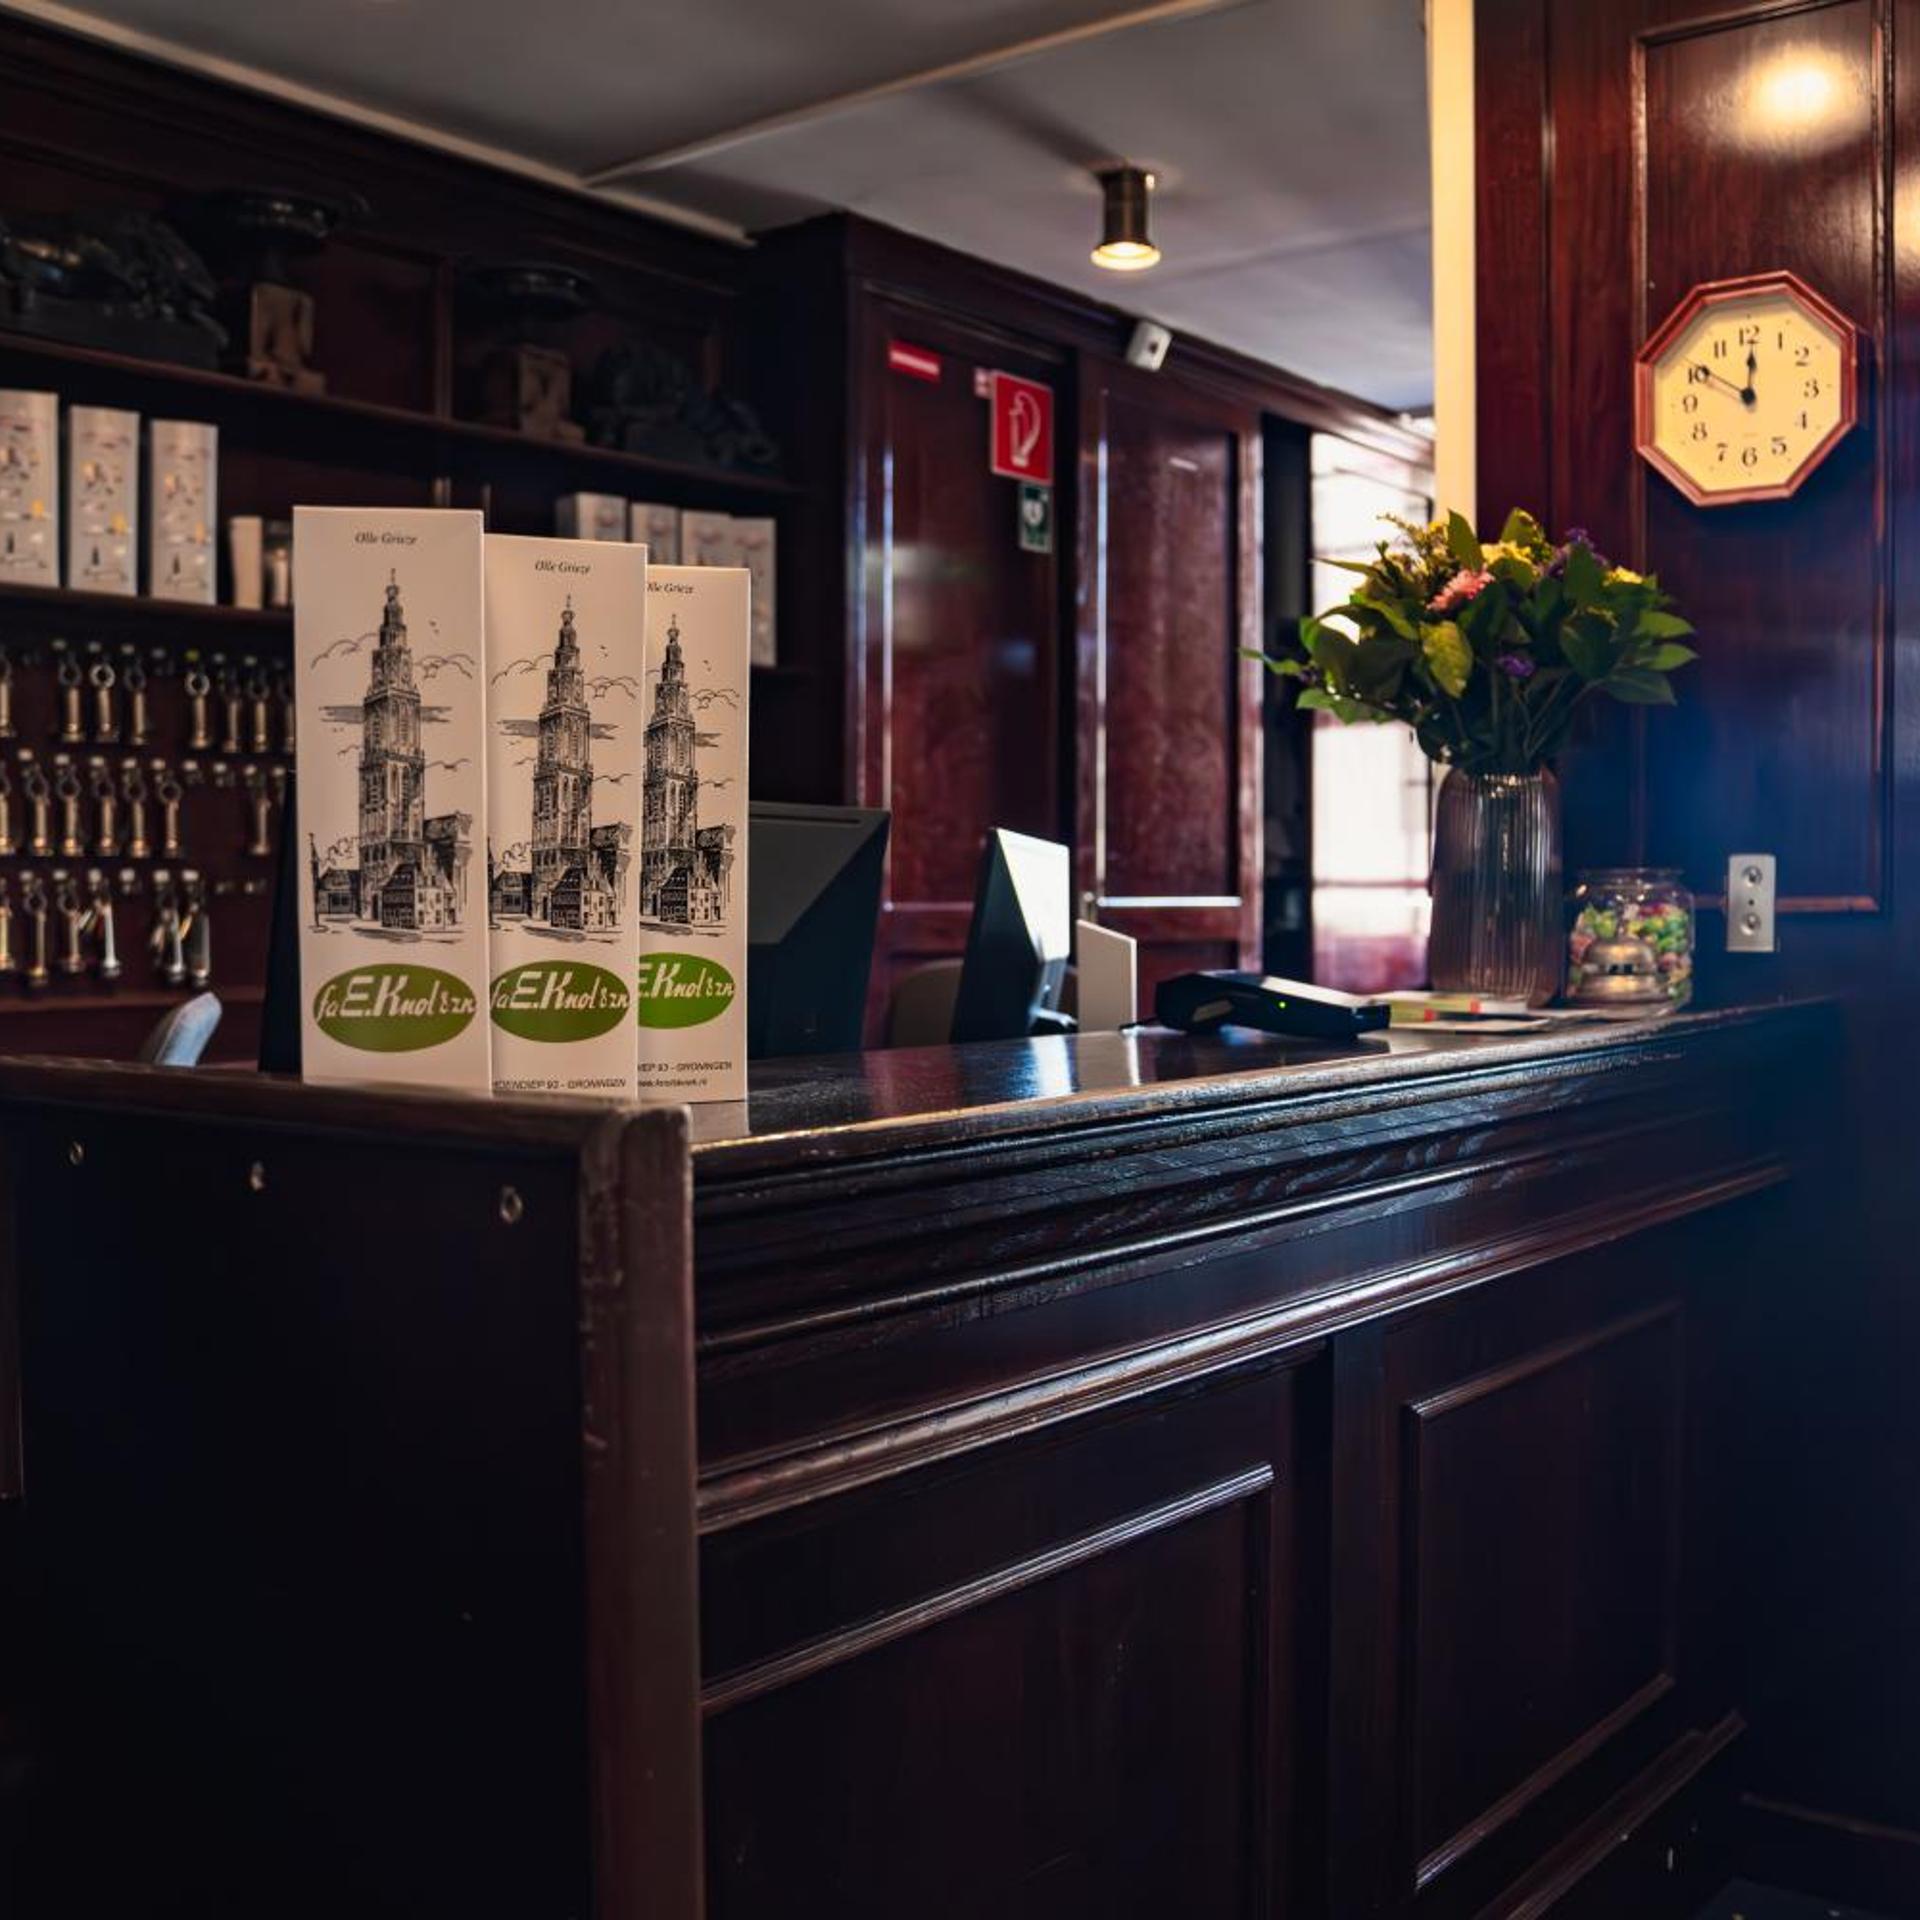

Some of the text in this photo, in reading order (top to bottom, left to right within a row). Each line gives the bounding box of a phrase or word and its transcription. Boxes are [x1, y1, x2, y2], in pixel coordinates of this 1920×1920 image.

[1738, 325, 1760, 347] 12
[1778, 332, 1783, 350] 1
[1713, 340, 1727, 358] 11
[1794, 347, 1810, 367] 2
[1688, 366, 1710, 384] 10
[1803, 379, 1820, 398] 3
[1682, 394, 1698, 413] 9
[1794, 411, 1808, 430] 4
[1692, 422, 1708, 441] 8
[1716, 443, 1728, 462] 7
[1771, 436, 1787, 455] 5
[1741, 447, 1758, 467] 6
[568, 1078, 626, 1089] GRONINGEN
